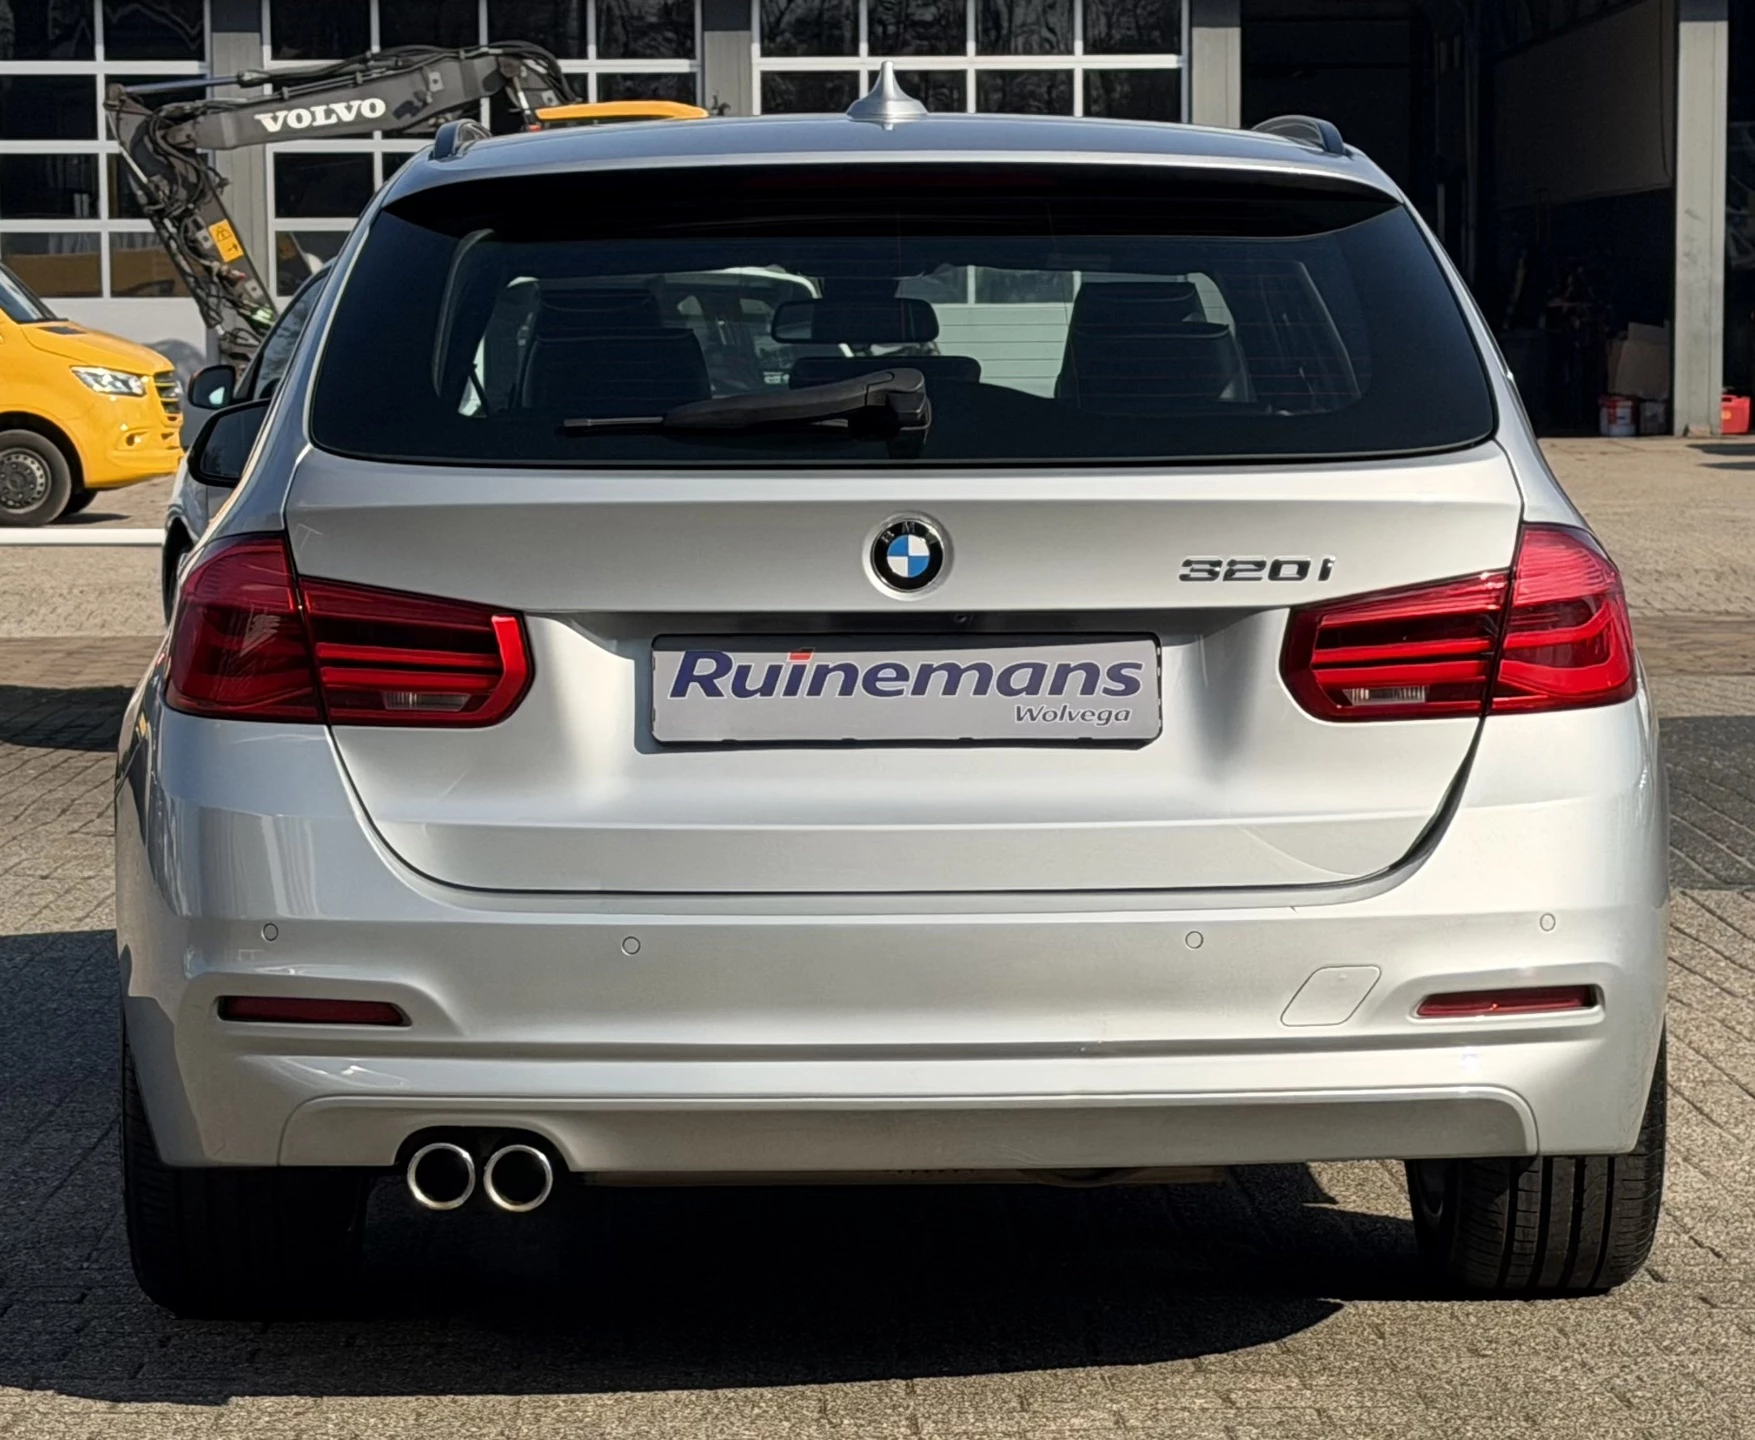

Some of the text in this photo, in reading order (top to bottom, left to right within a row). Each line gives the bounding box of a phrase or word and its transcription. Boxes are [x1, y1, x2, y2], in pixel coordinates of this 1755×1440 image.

[254, 98, 386, 132] VOLVO
[1179, 555, 1336, 582] 320i
[667, 648, 1143, 700] Ruinemans
[1015, 704, 1131, 726] Wolvega
